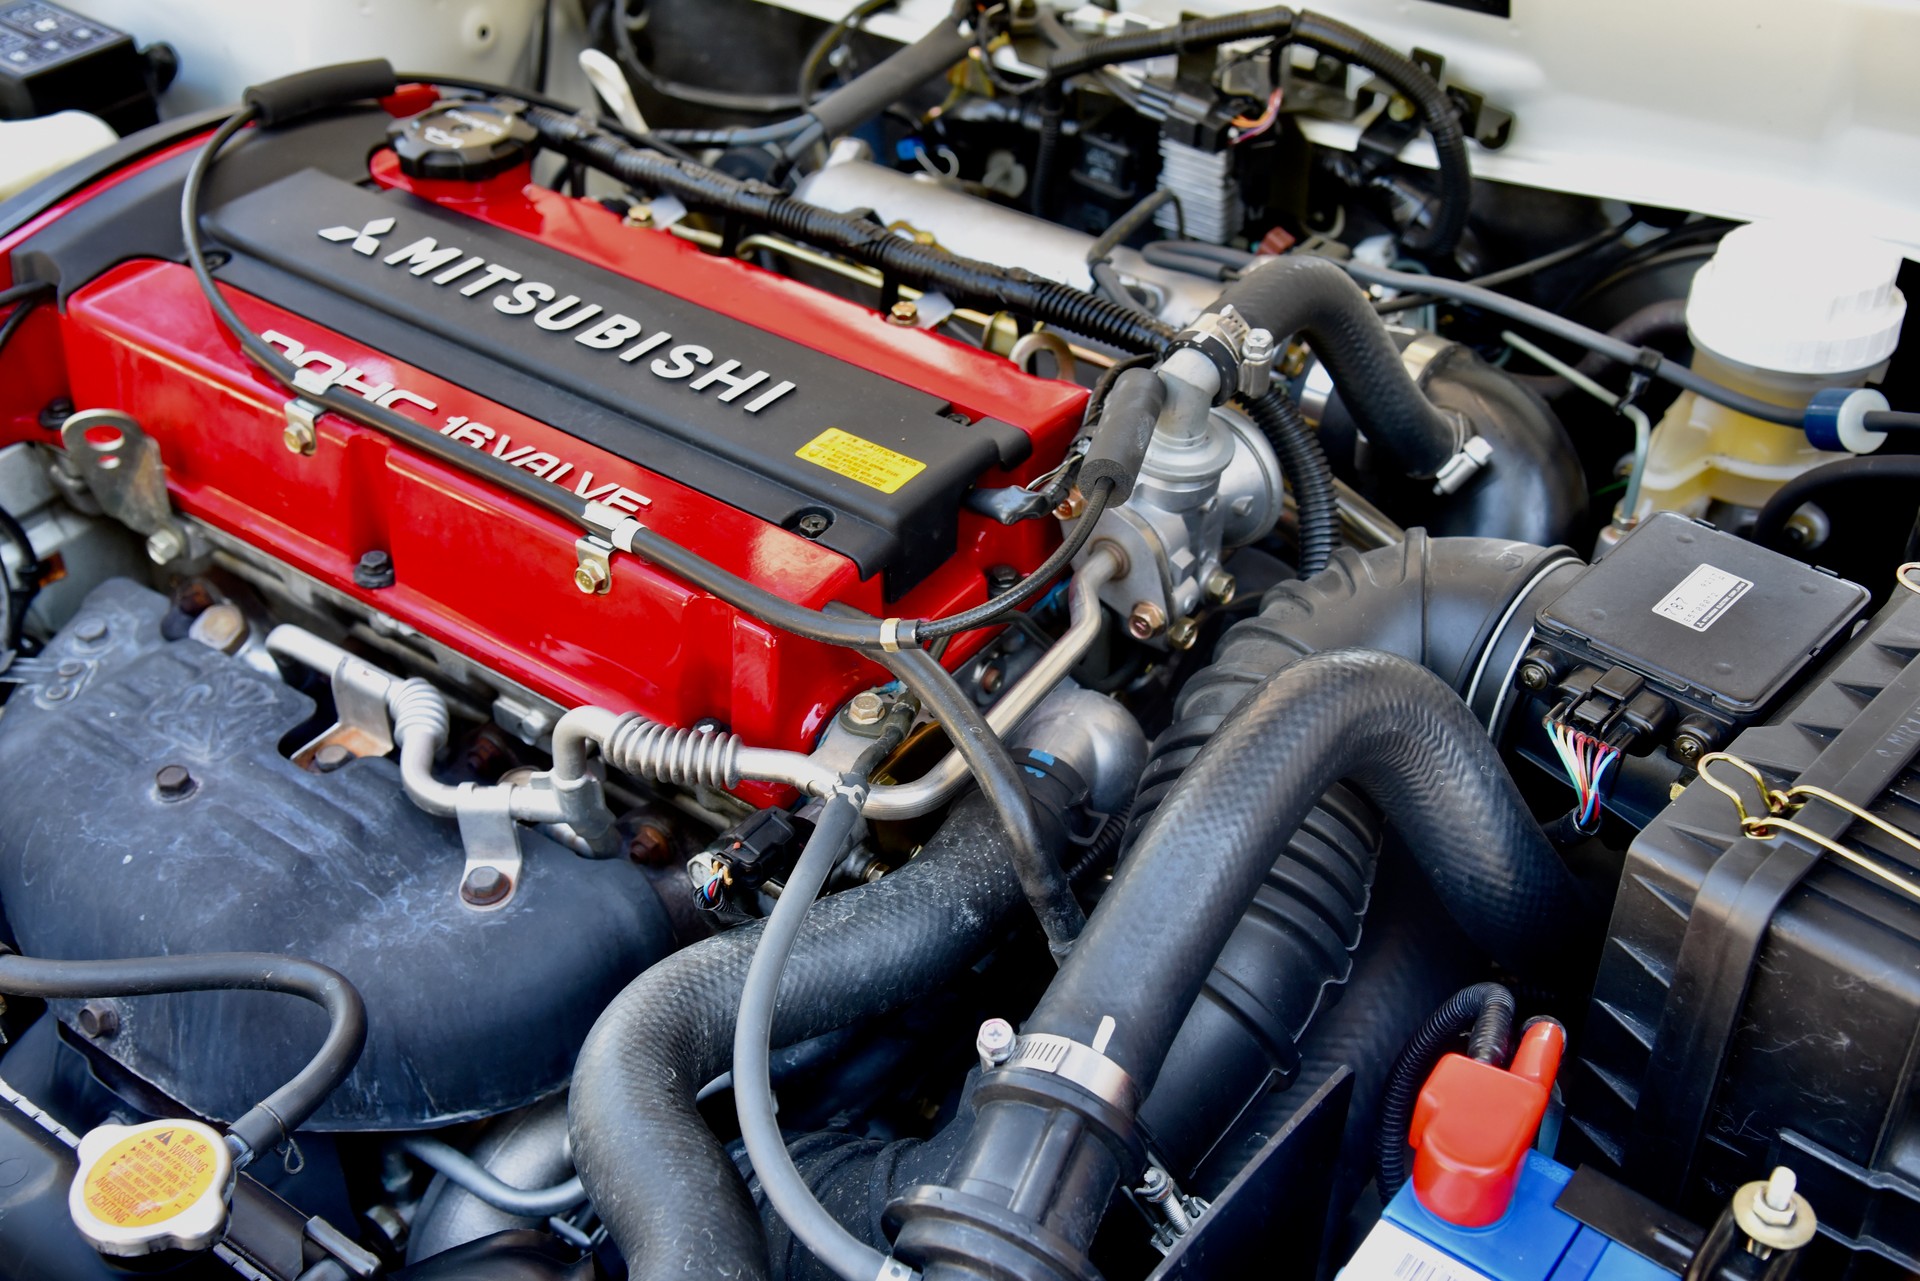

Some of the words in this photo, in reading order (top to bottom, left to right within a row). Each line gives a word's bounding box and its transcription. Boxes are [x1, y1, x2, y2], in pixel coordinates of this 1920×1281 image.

[383, 235, 797, 413] MITSUBISHI
[1663, 596, 1688, 616] 787
[168, 1142, 209, 1174] WARNING
[88, 1191, 131, 1225] ACHTUNG
